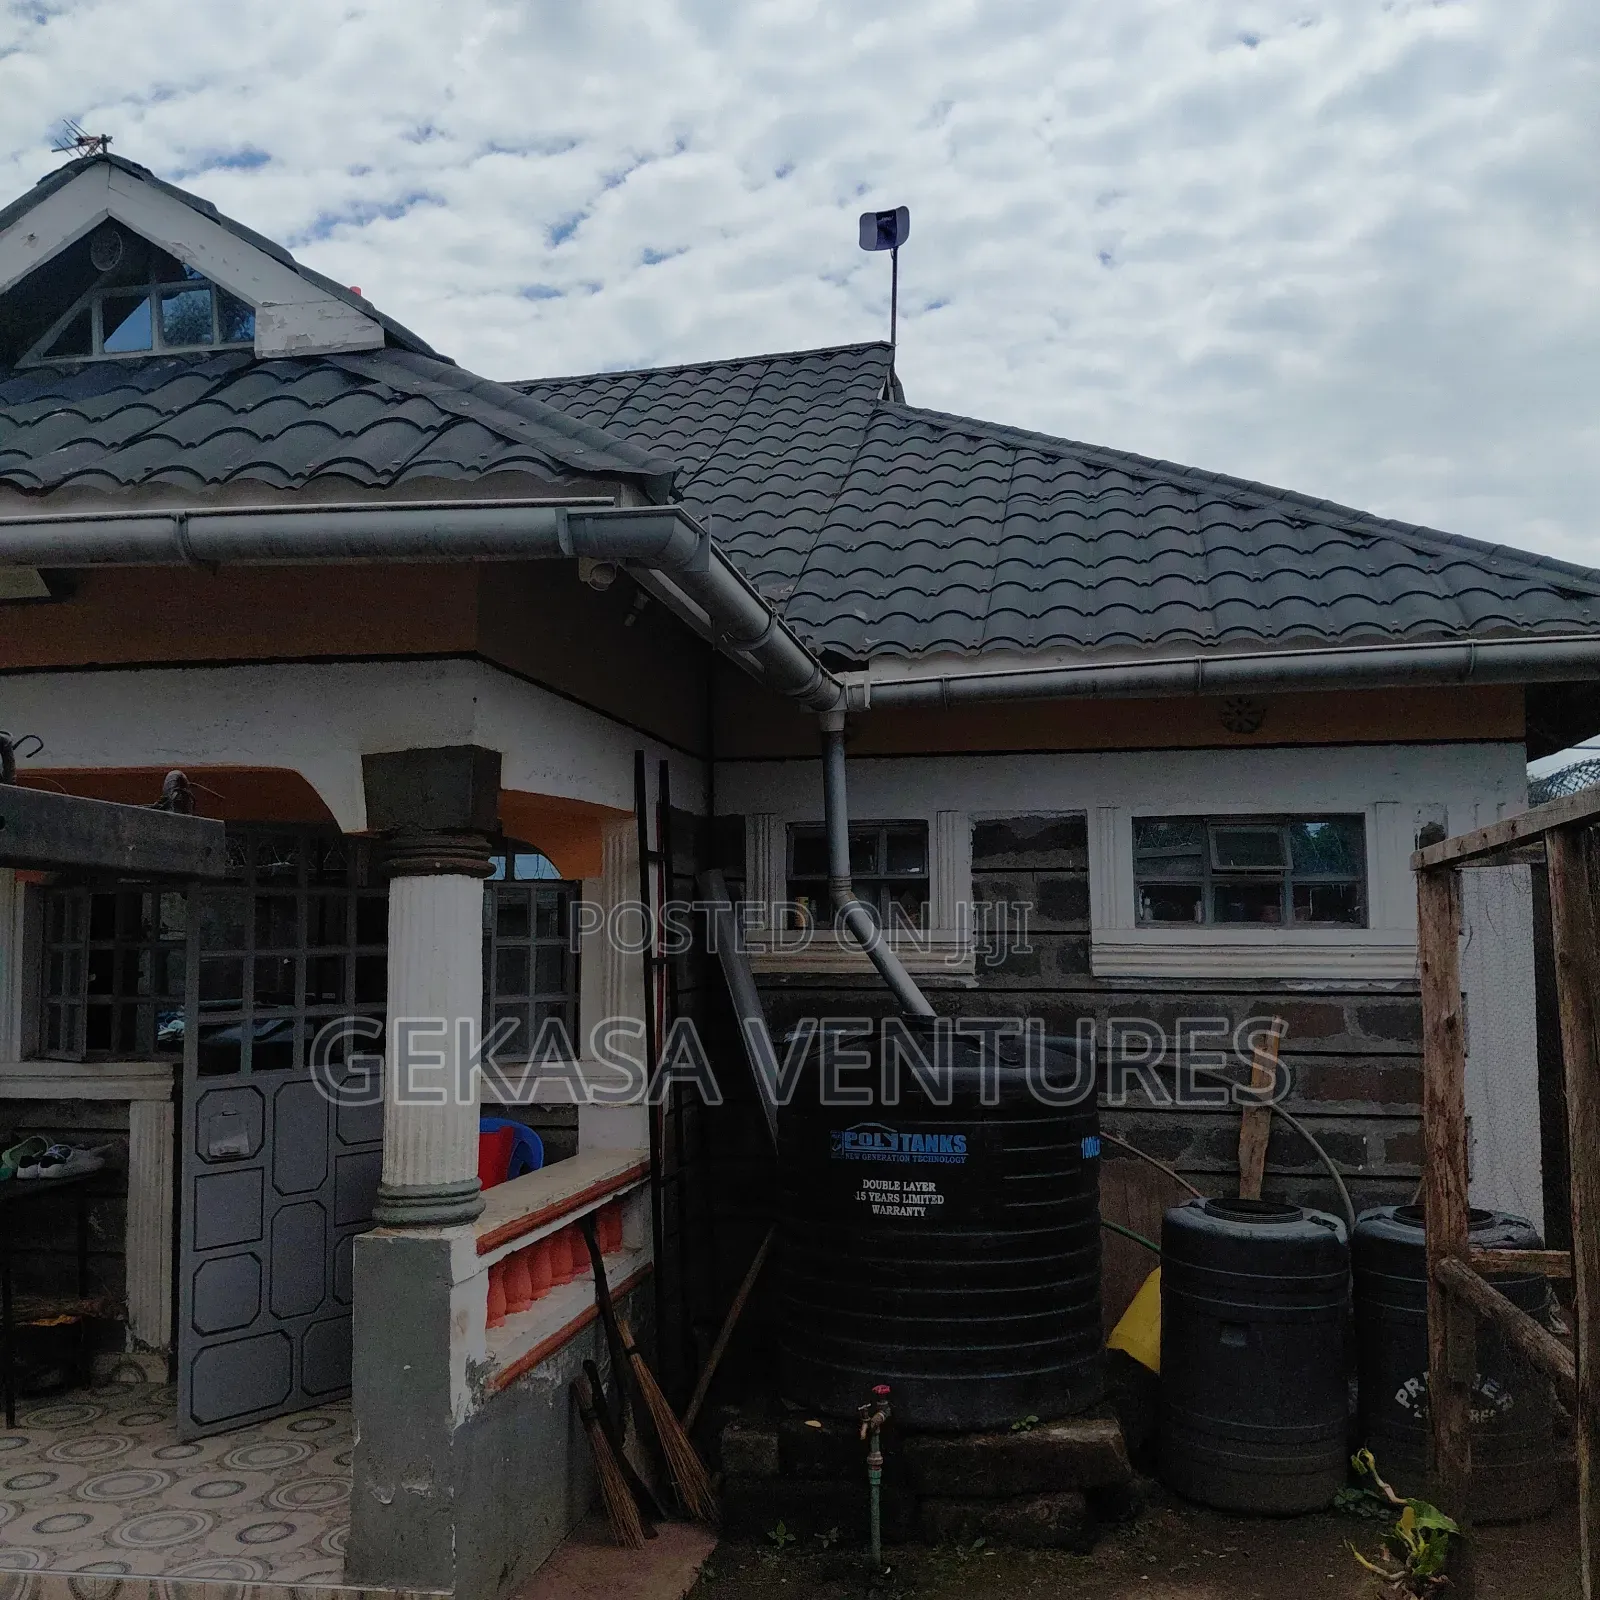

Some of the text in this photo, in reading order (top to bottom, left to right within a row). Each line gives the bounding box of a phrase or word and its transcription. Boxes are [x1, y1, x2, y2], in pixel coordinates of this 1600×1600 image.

[845, 1152, 967, 1163] NEW GENERATION TECHNOLOGY
[862, 1179, 936, 1192] DOUBLE LAYER
[855, 1191, 944, 1205] 15 YEARS LIMITED
[872, 1204, 926, 1217] WARRANTY
